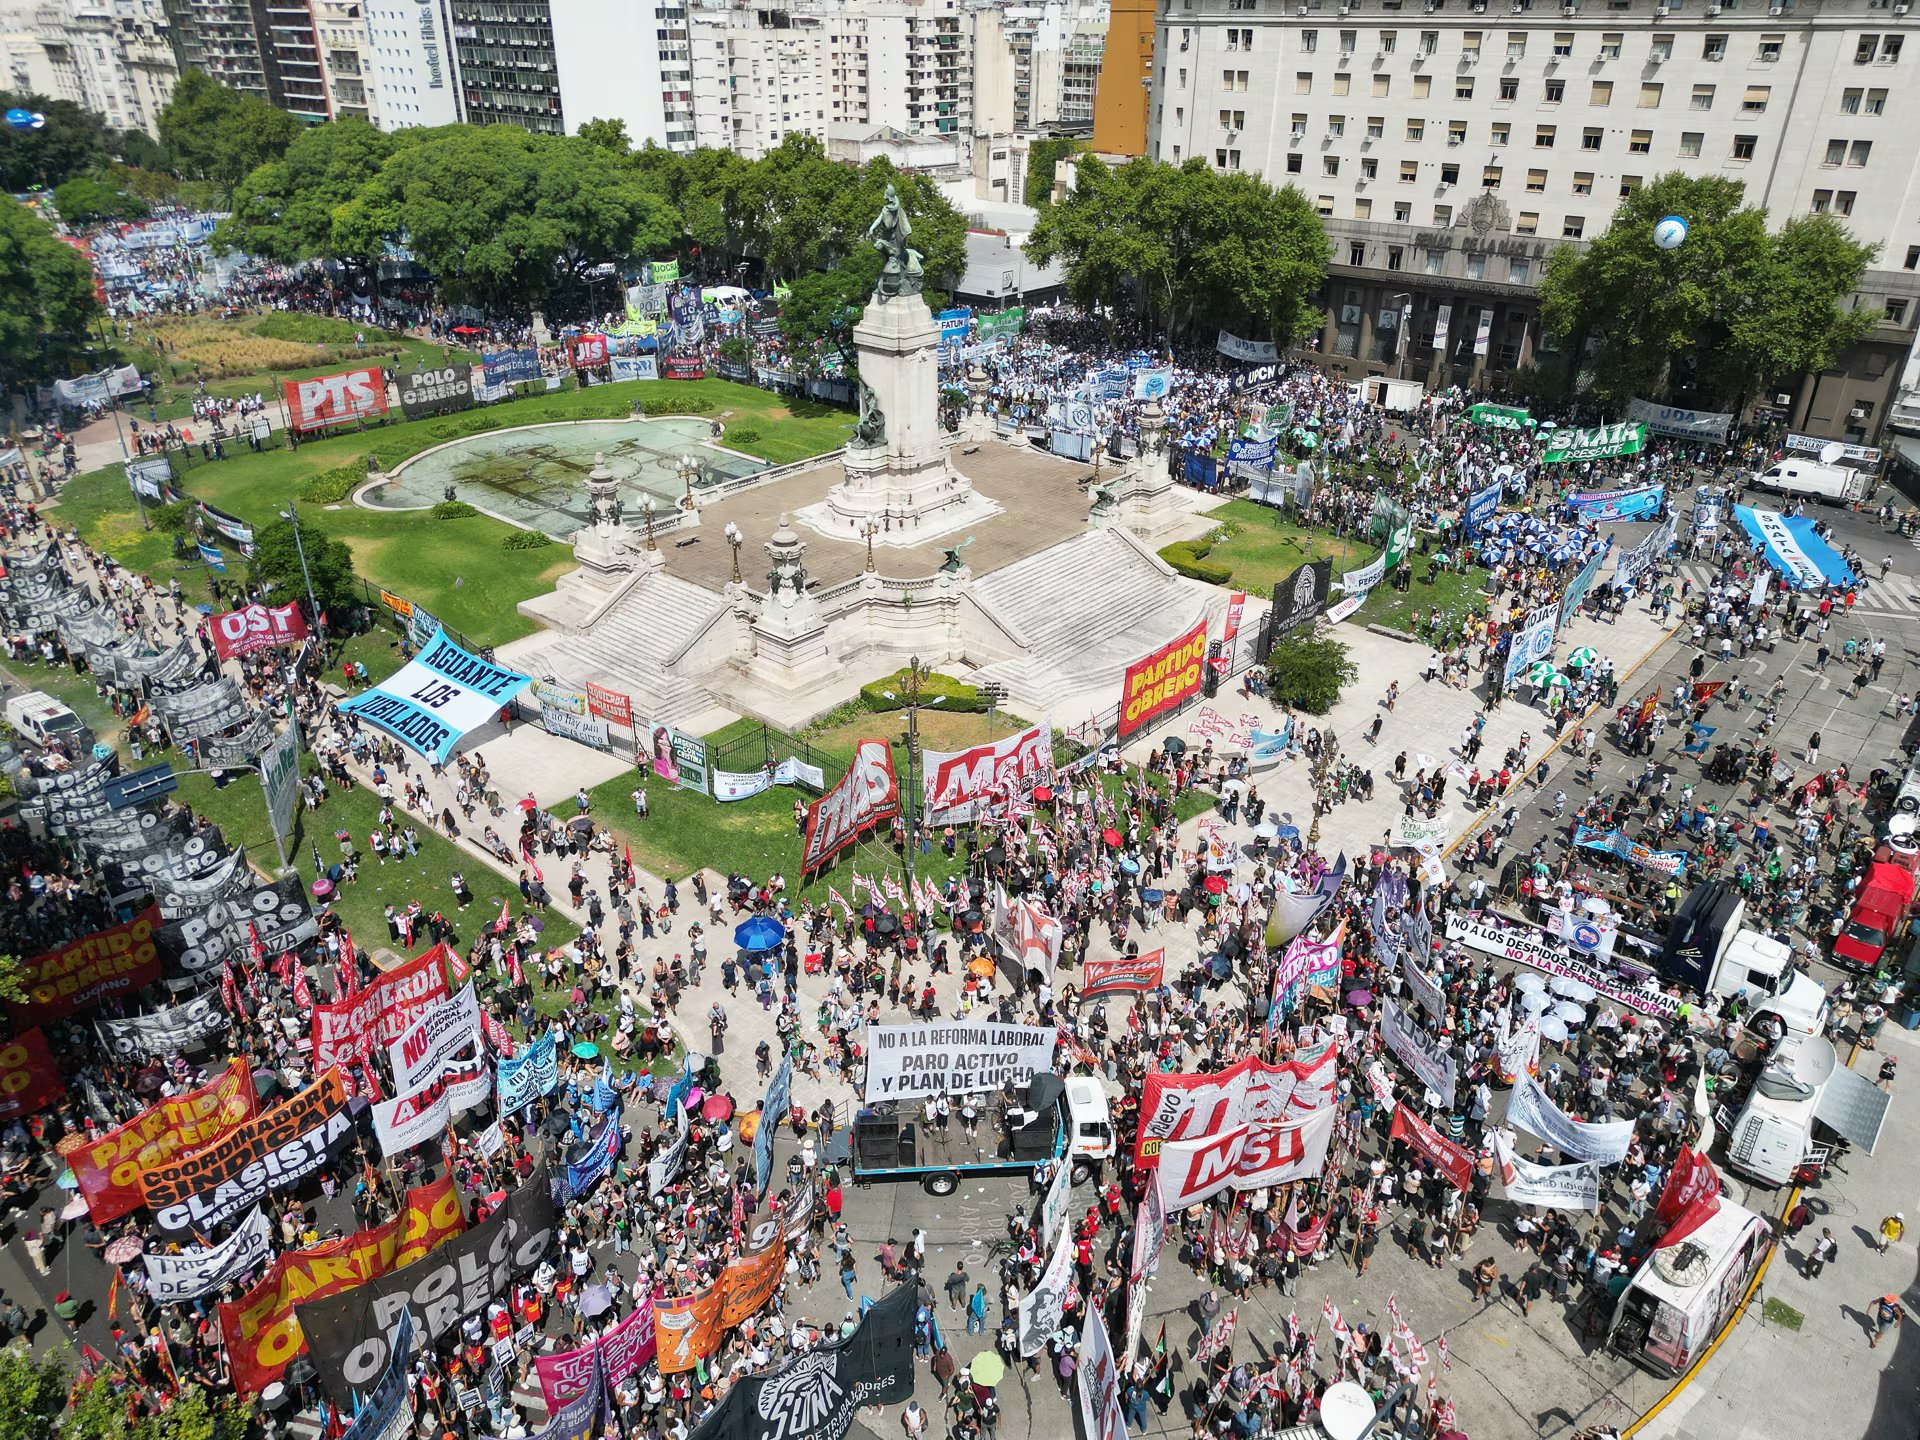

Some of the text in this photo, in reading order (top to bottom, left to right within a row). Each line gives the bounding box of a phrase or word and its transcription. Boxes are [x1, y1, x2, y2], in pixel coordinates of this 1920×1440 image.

[419, 7, 443, 88] hotel ibis
[941, 319, 965, 329] FATUN
[512, 361, 525, 370] DEL
[576, 341, 604, 363] JIS
[1247, 364, 1276, 384] UPCN
[298, 371, 376, 421] PTS
[402, 380, 468, 406] OBRERO
[411, 367, 456, 388] POLO
[1550, 420, 1641, 450] SMATA
[1564, 444, 1624, 460] PRESENTE
[220, 604, 293, 641] OST
[234, 644, 251, 654] DE LOS
[424, 640, 522, 697] AGUANTE
[1130, 634, 1207, 698] PARTIDO
[410, 679, 462, 709] LOS
[1126, 663, 1200, 721] OBRERO
[347, 694, 450, 752] JUBILADOS
[564, 713, 581, 730] hay
[582, 723, 599, 734] pan
[676, 750, 703, 766] CRISTINA
[682, 744, 696, 756] CON
[811, 805, 828, 853] nuevo
[1631, 845, 1650, 857] NO
[121, 836, 205, 877] POLO
[1630, 852, 1680, 869] REFORMA
[179, 890, 281, 948] POLO
[179, 903, 303, 970] OBRERO
[23, 919, 153, 986] PARTIDO
[1450, 917, 1469, 932] NO
[1469, 922, 1480, 935] A
[1480, 927, 1504, 944] LOS
[1505, 937, 1568, 966] DESPIDOS
[1569, 959, 1588, 975] EN
[1587, 967, 1603, 982] EL
[30, 941, 158, 1005] OBRERO
[1504, 947, 1676, 1020] NO A LA REFORMA LABORAL
[318, 960, 443, 1043] IZQUIERDA
[425, 1000, 463, 1027] REFORMA
[426, 1009, 461, 1037] LABORAL
[402, 1025, 428, 1070] NO
[428, 1009, 472, 1044] ESCLAVISTA
[878, 1028, 1047, 1049] NO A LA REFORMA LABORAL
[881, 1066, 1035, 1093] Y PLAN DE LUCHA
[901, 1052, 1019, 1072] PARO ACTIVO
[90, 1075, 242, 1170] PARTIDO
[143, 1078, 335, 1188] COORDINADORA
[1150, 1092, 1182, 1137] nuevo
[110, 1093, 250, 1187] OBRERO
[145, 1093, 345, 1209] SINDICAL
[1193, 1129, 1293, 1188] MST
[156, 1111, 352, 1231] CLASISTA
[201, 1152, 328, 1229] PARTIDO OBRERO
[160, 1279, 190, 1294] DE
[238, 1192, 462, 1341] PARTIDO
[372, 1218, 519, 1331] POLO
[342, 1228, 552, 1384] OBRERO
